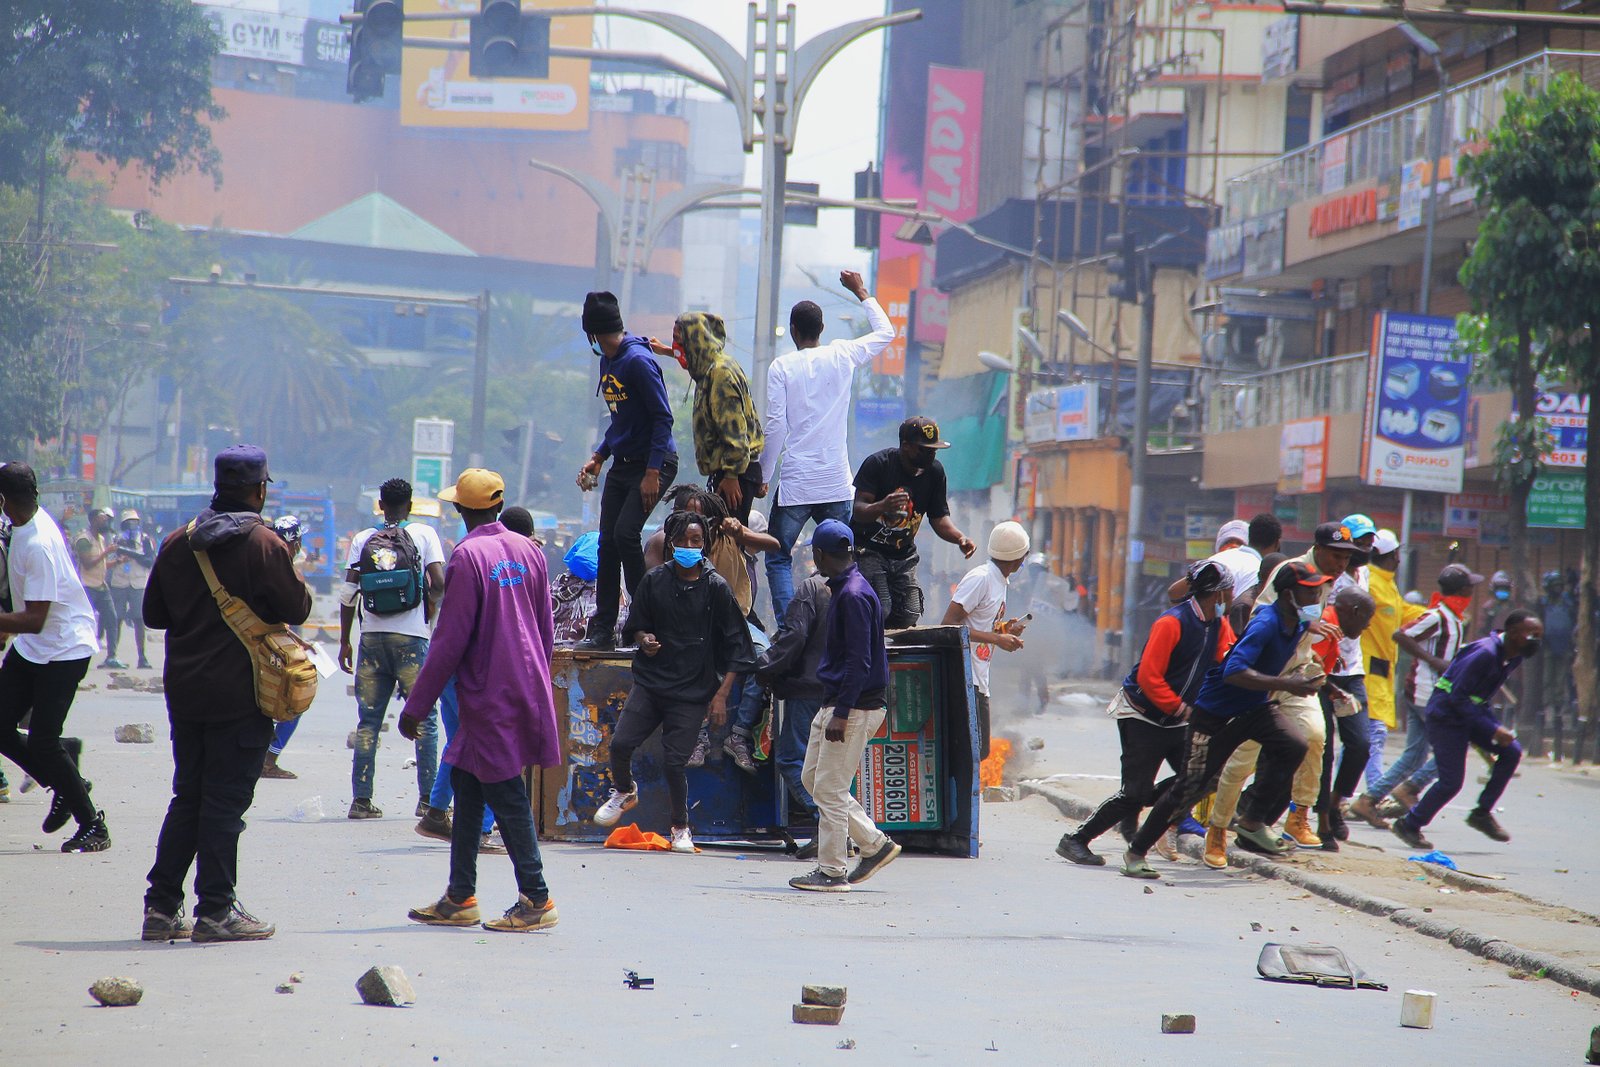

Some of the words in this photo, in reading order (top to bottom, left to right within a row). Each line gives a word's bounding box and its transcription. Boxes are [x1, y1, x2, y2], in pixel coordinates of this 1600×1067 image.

[232, 22, 280, 50] GYM
[926, 83, 967, 213] LADY
[1427, 324, 1448, 338] STOP
[1404, 455, 1449, 467] RIKKO
[874, 747, 882, 785] AGENT
[885, 744, 907, 822] 2039603
[909, 751, 917, 791] AGENT
